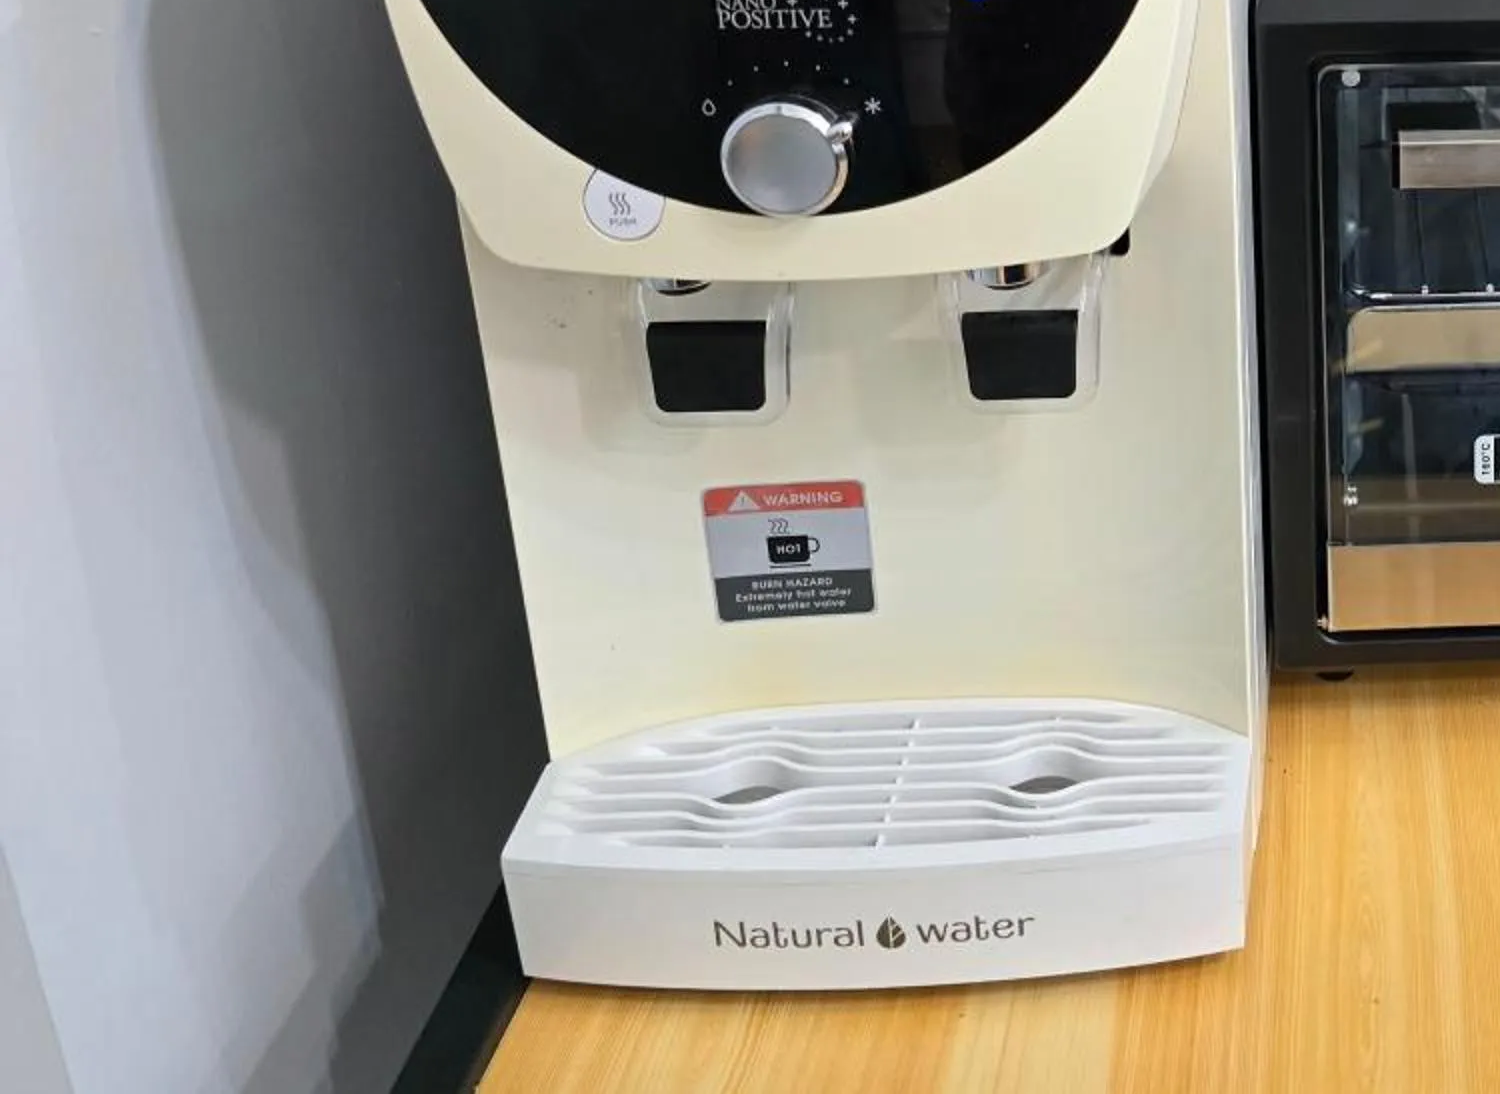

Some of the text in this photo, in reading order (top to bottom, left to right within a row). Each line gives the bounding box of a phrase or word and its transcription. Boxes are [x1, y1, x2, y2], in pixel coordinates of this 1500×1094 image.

[717, 8, 832, 30] POSITIVE
[763, 491, 843, 506] WARNING
[776, 543, 801, 555] HOT
[751, 577, 833, 591] BURN HAZARD
[735, 587, 851, 603] Extremely hot water
[747, 599, 846, 612] from water valve
[713, 914, 1035, 949] Natural water
